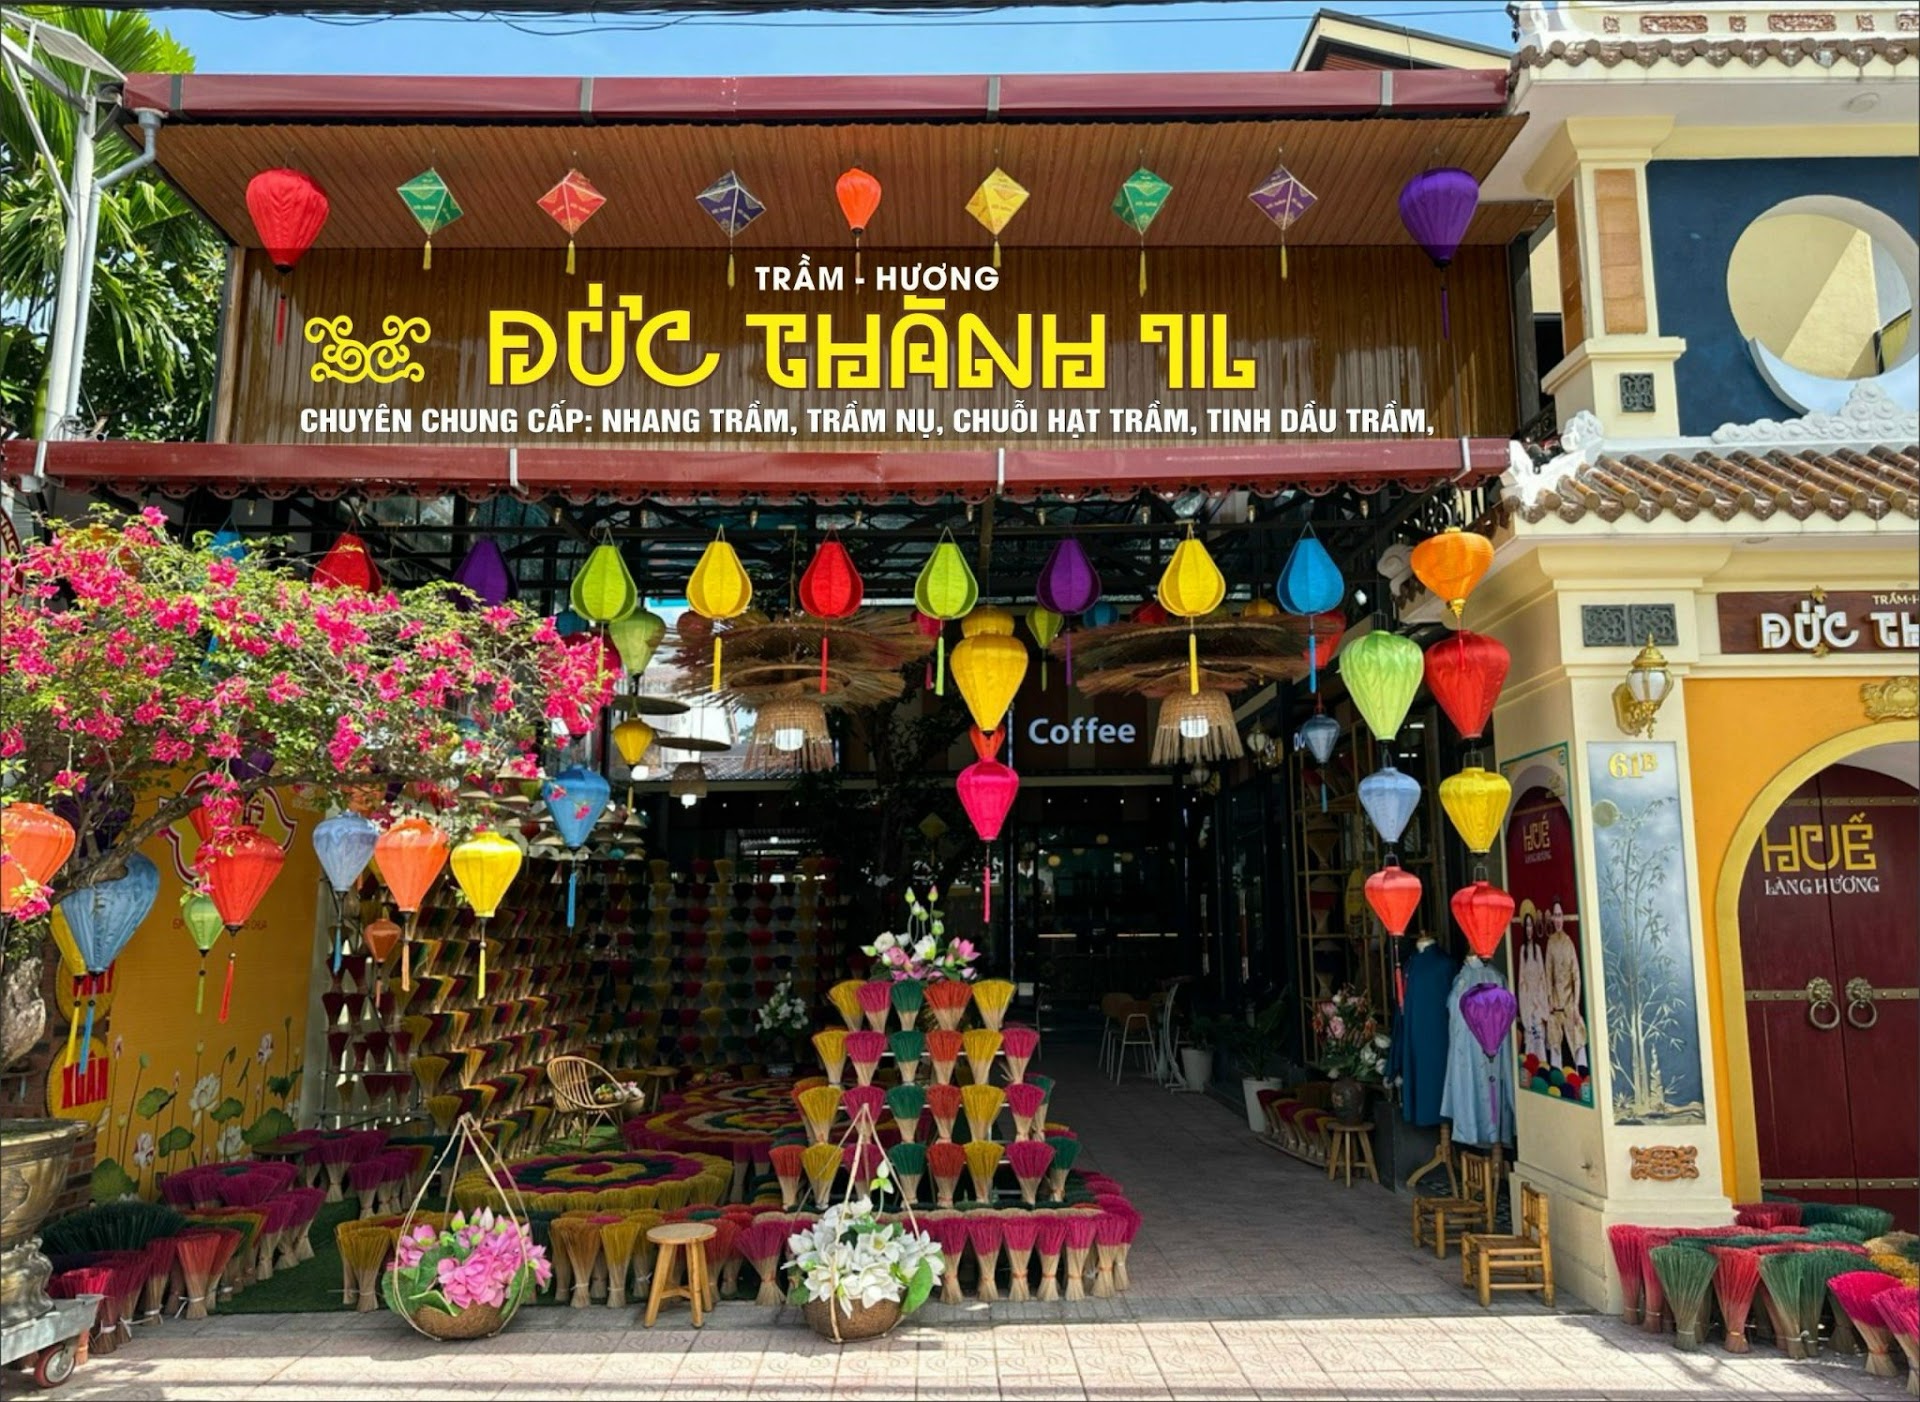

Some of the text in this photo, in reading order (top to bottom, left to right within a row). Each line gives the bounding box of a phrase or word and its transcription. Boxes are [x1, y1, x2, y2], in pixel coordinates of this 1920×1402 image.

[754, 253, 844, 291] TRẦM
[876, 263, 999, 291] HƯƠNG
[489, 283, 720, 387] ĐỨC
[746, 294, 1105, 388] THÀNH
[300, 399, 1434, 438] CHUYÊN CHUNG CẤP: NHANG TRẦM, TRẦM NỤ, CHUỖI HẠT TRẦM, TINH DẦU TRẦM,
[1759, 600, 1860, 649] ĐỨC
[1028, 716, 1136, 745] Coffee
[1608, 752, 1658, 779] 61B
[1759, 812, 1877, 872] HUẾ
[1764, 874, 1880, 895] LÀNG HƯƠNG
